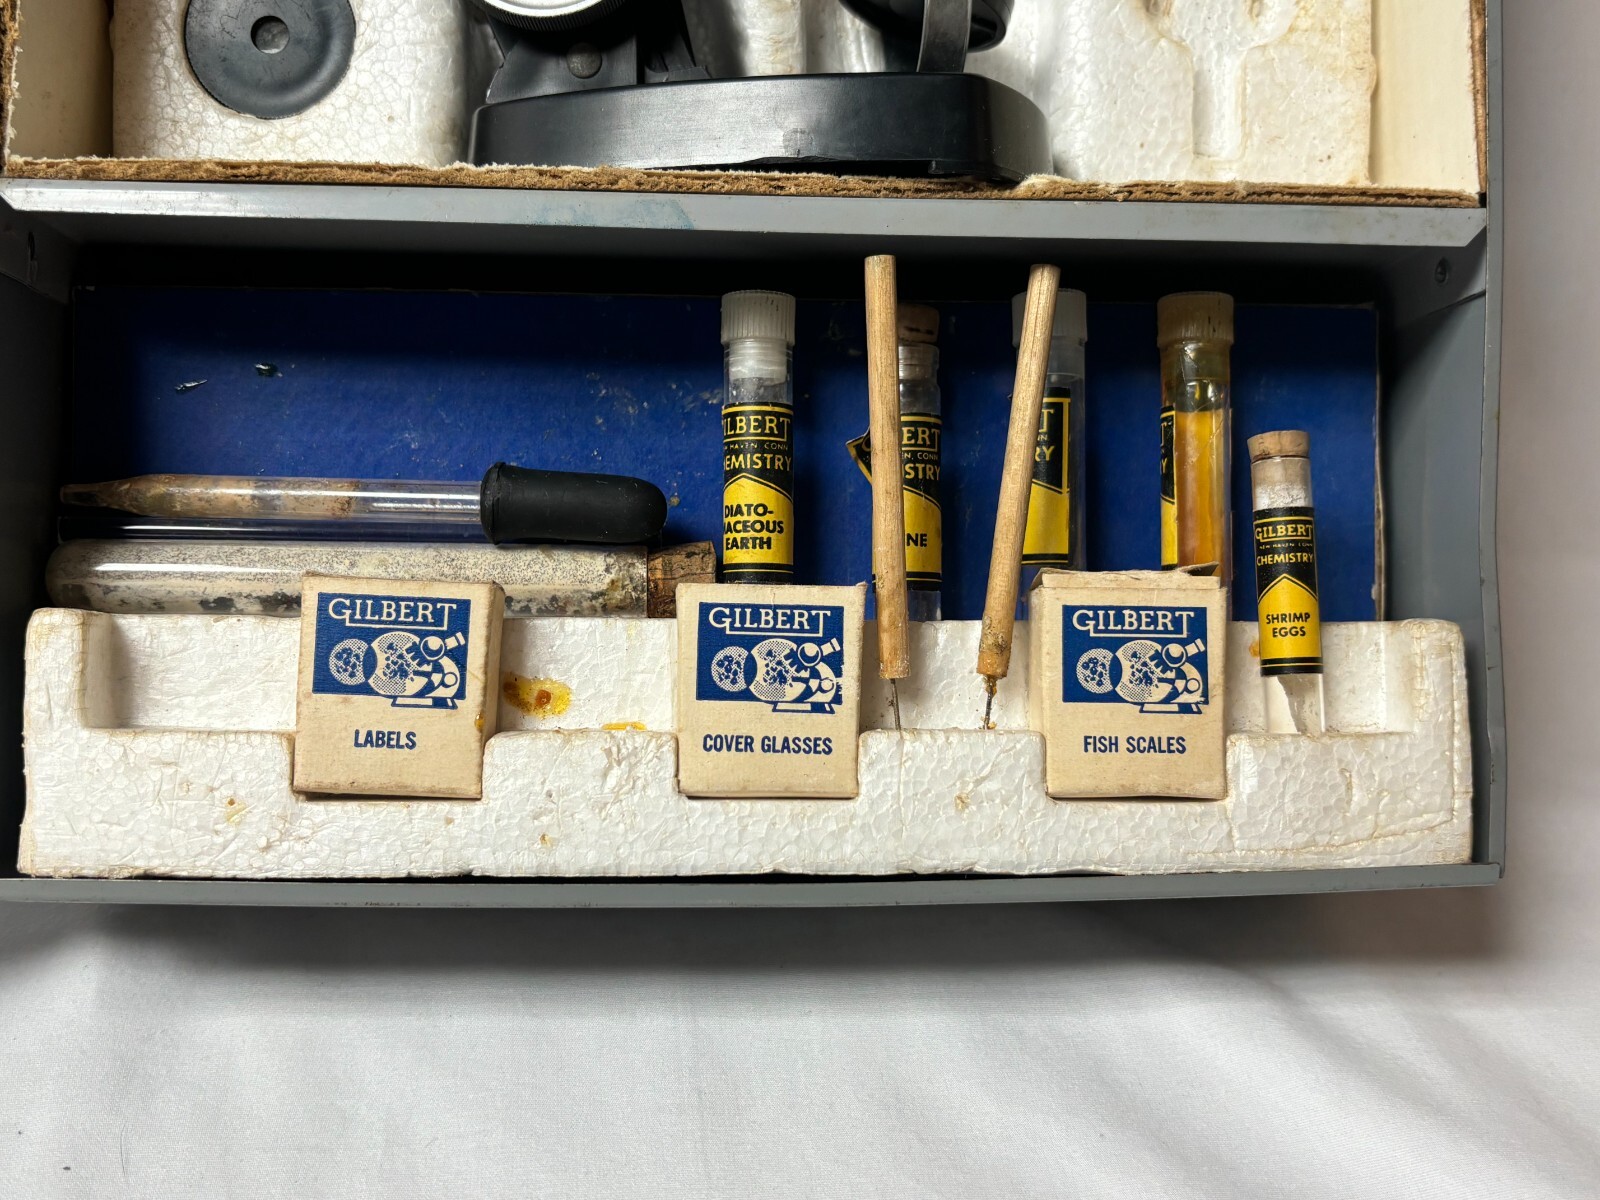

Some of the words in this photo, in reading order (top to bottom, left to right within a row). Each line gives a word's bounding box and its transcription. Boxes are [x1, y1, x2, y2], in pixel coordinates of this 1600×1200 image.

[723, 415, 791, 442] ILBERT
[724, 503, 774, 518] DIATO-
[1255, 523, 1313, 542] GILBERT
[725, 536, 772, 551] EARTH
[1256, 552, 1313, 566] CHEMISTRY
[328, 598, 457, 631] GILBERT
[708, 607, 831, 637] GILBERT
[1072, 609, 1195, 638] GILBERT
[1265, 612, 1311, 625] SHRIMP
[1271, 626, 1306, 638] EGGS
[353, 729, 417, 750] LABELS
[702, 733, 755, 753] COVER
[761, 735, 833, 755] GLASSES
[1083, 735, 1119, 753] FISH
[1125, 736, 1187, 754] SCALES
